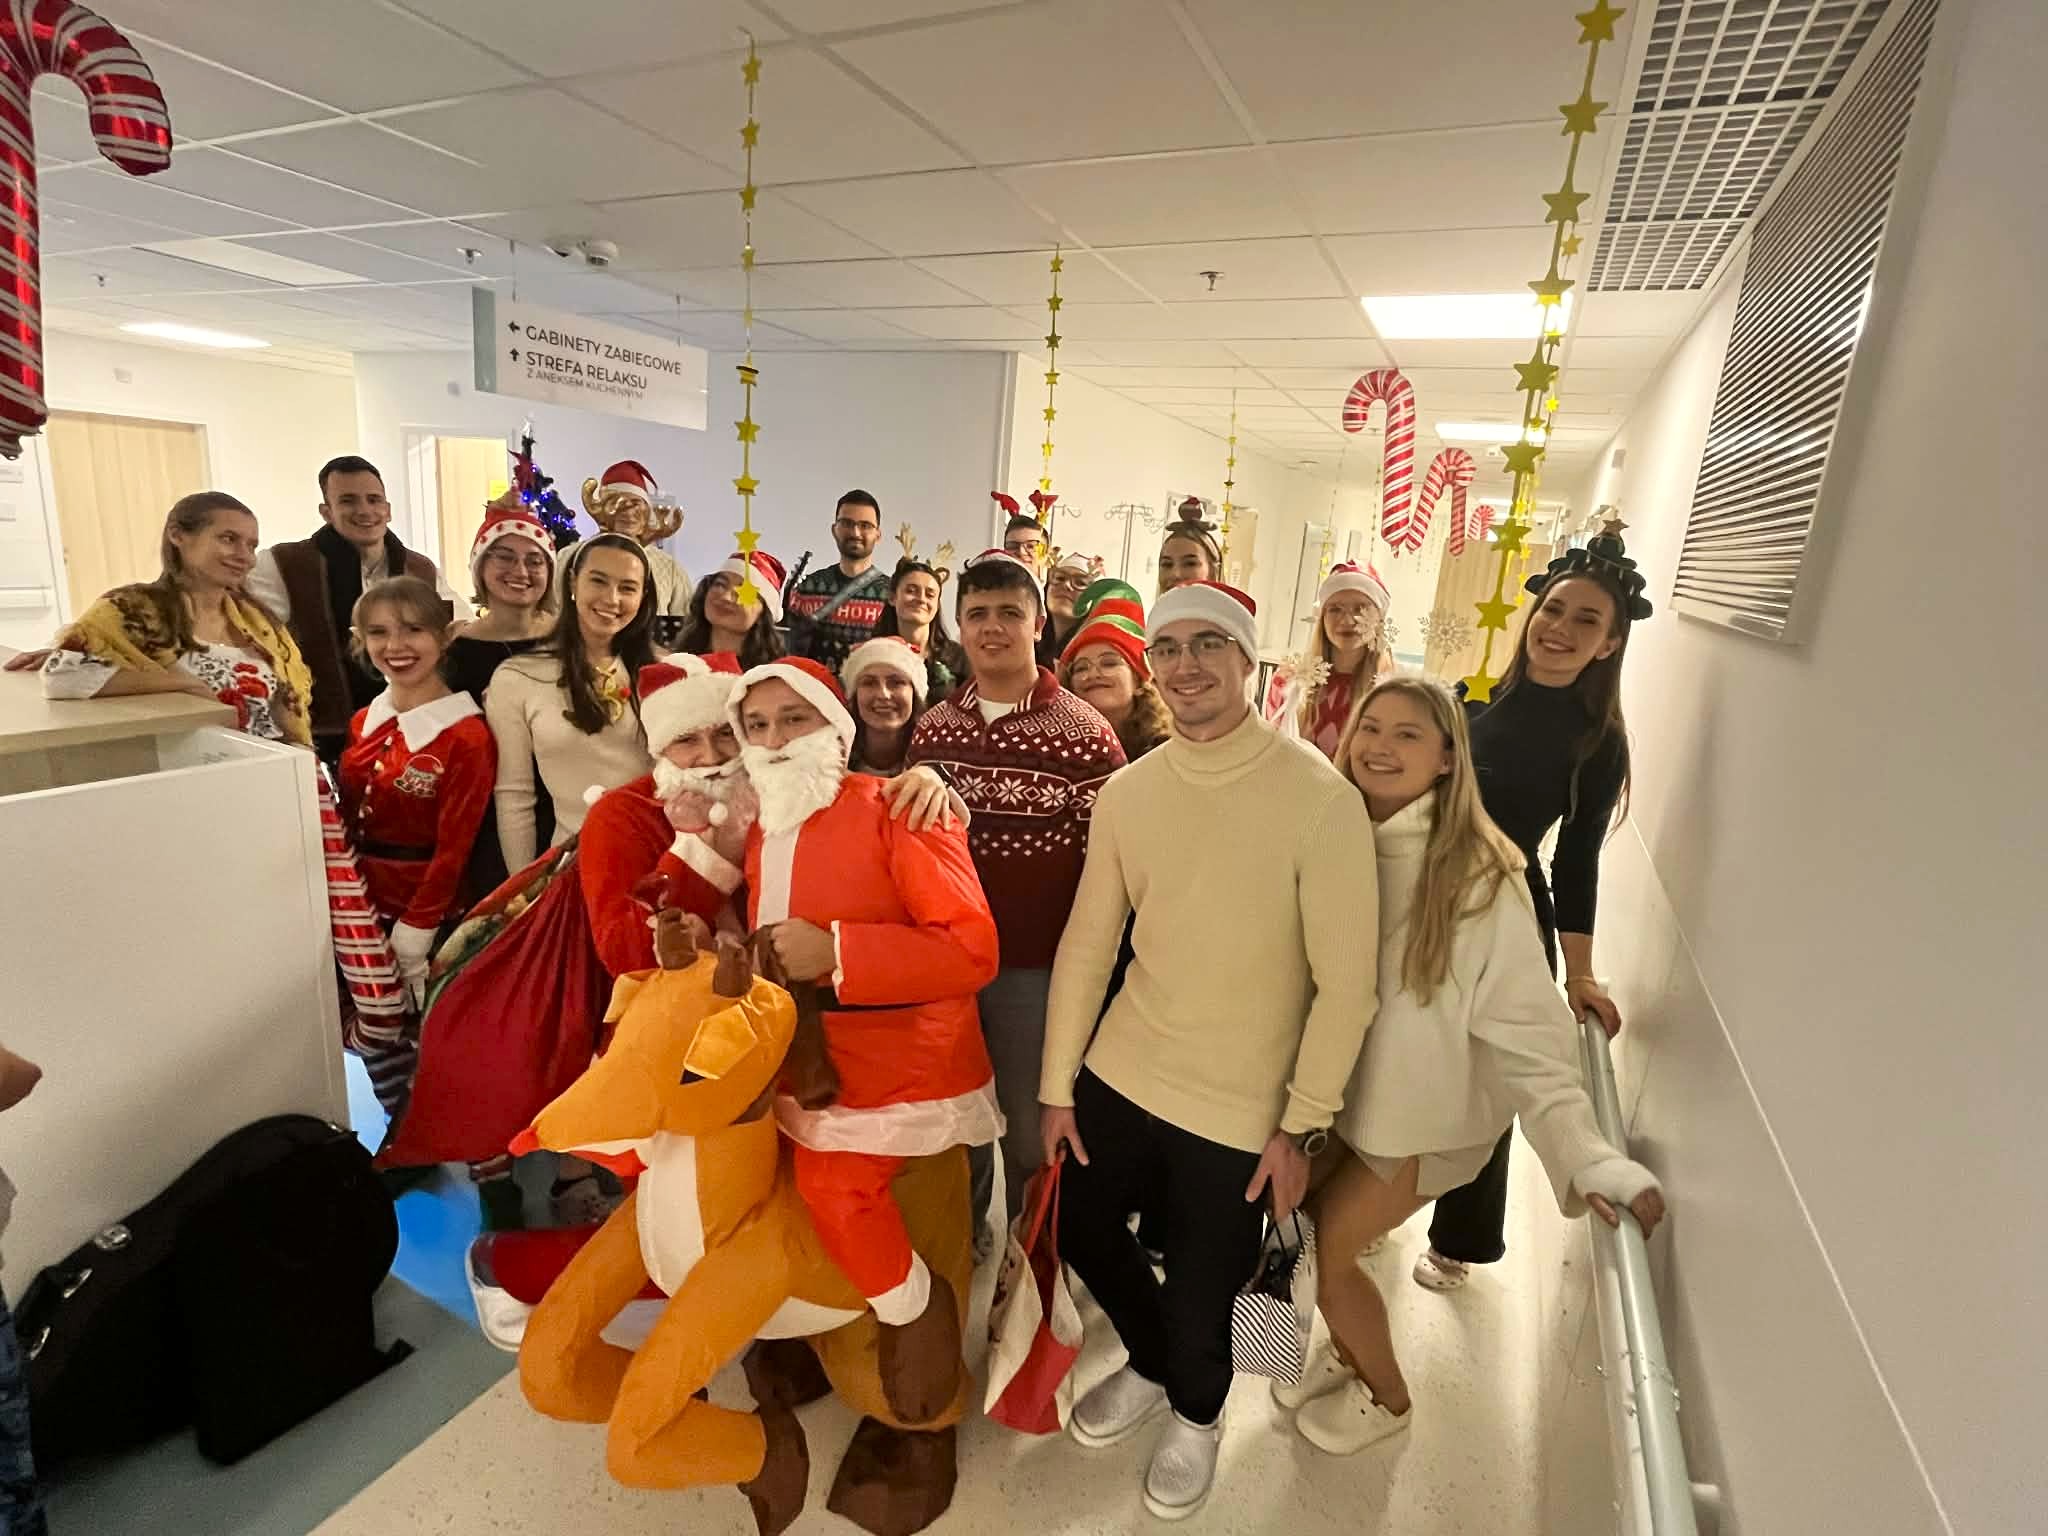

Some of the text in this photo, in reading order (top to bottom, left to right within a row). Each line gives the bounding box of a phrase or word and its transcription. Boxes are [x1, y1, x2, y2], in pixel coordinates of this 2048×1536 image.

[526, 326, 681, 375] GABINETY ZABIEGOWE
[526, 352, 647, 389] STREFA RELAKSU
[527, 367, 534, 378] Z
